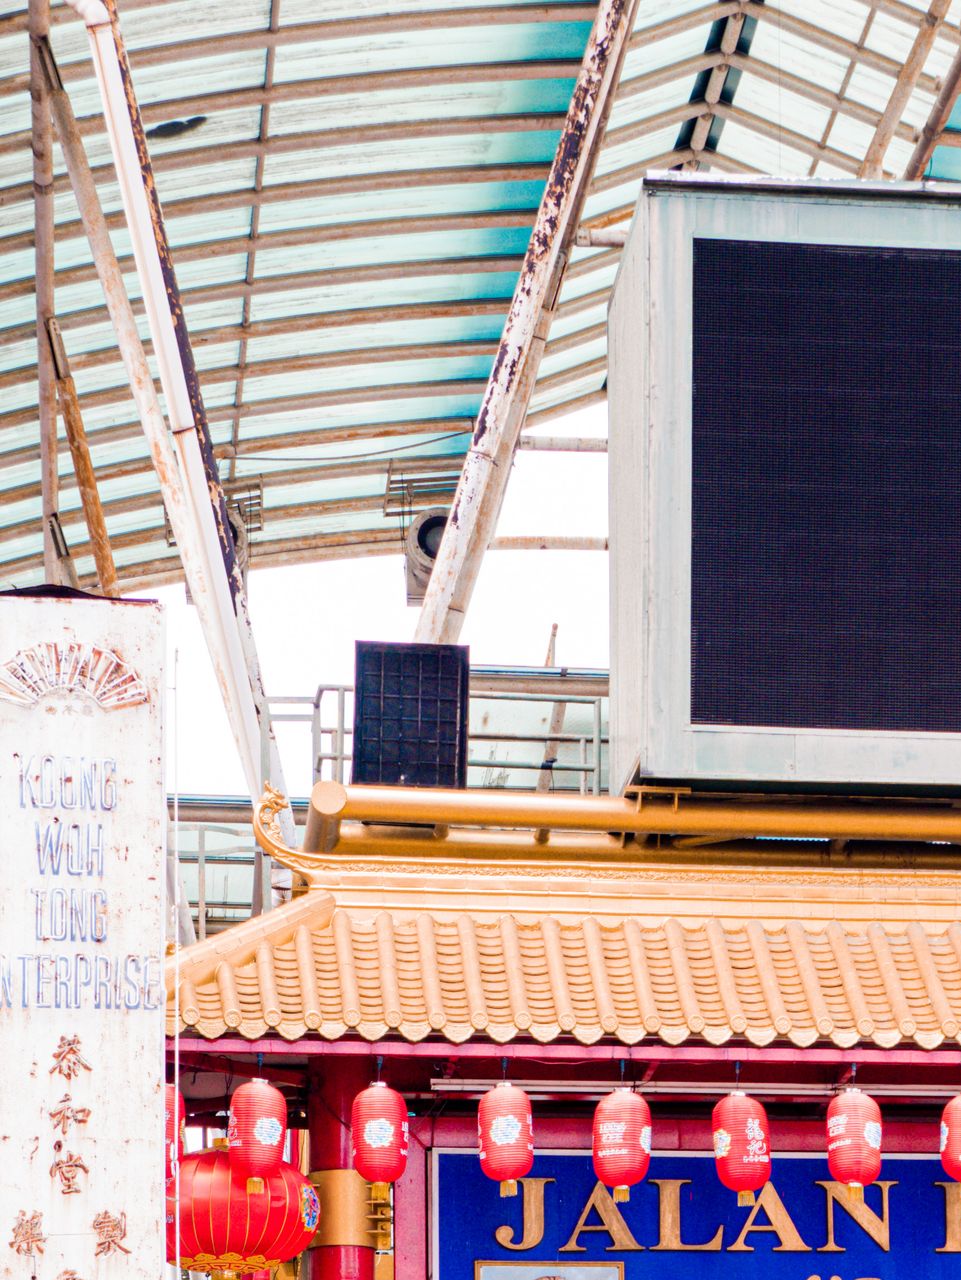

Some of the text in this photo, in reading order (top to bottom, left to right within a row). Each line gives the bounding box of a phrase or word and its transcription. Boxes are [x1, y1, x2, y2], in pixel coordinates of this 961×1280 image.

[15, 754, 118, 810] KOONG
[34, 822, 105, 877] WOH
[32, 888, 108, 942] TONG
[495, 1177, 899, 1253] JALAN
